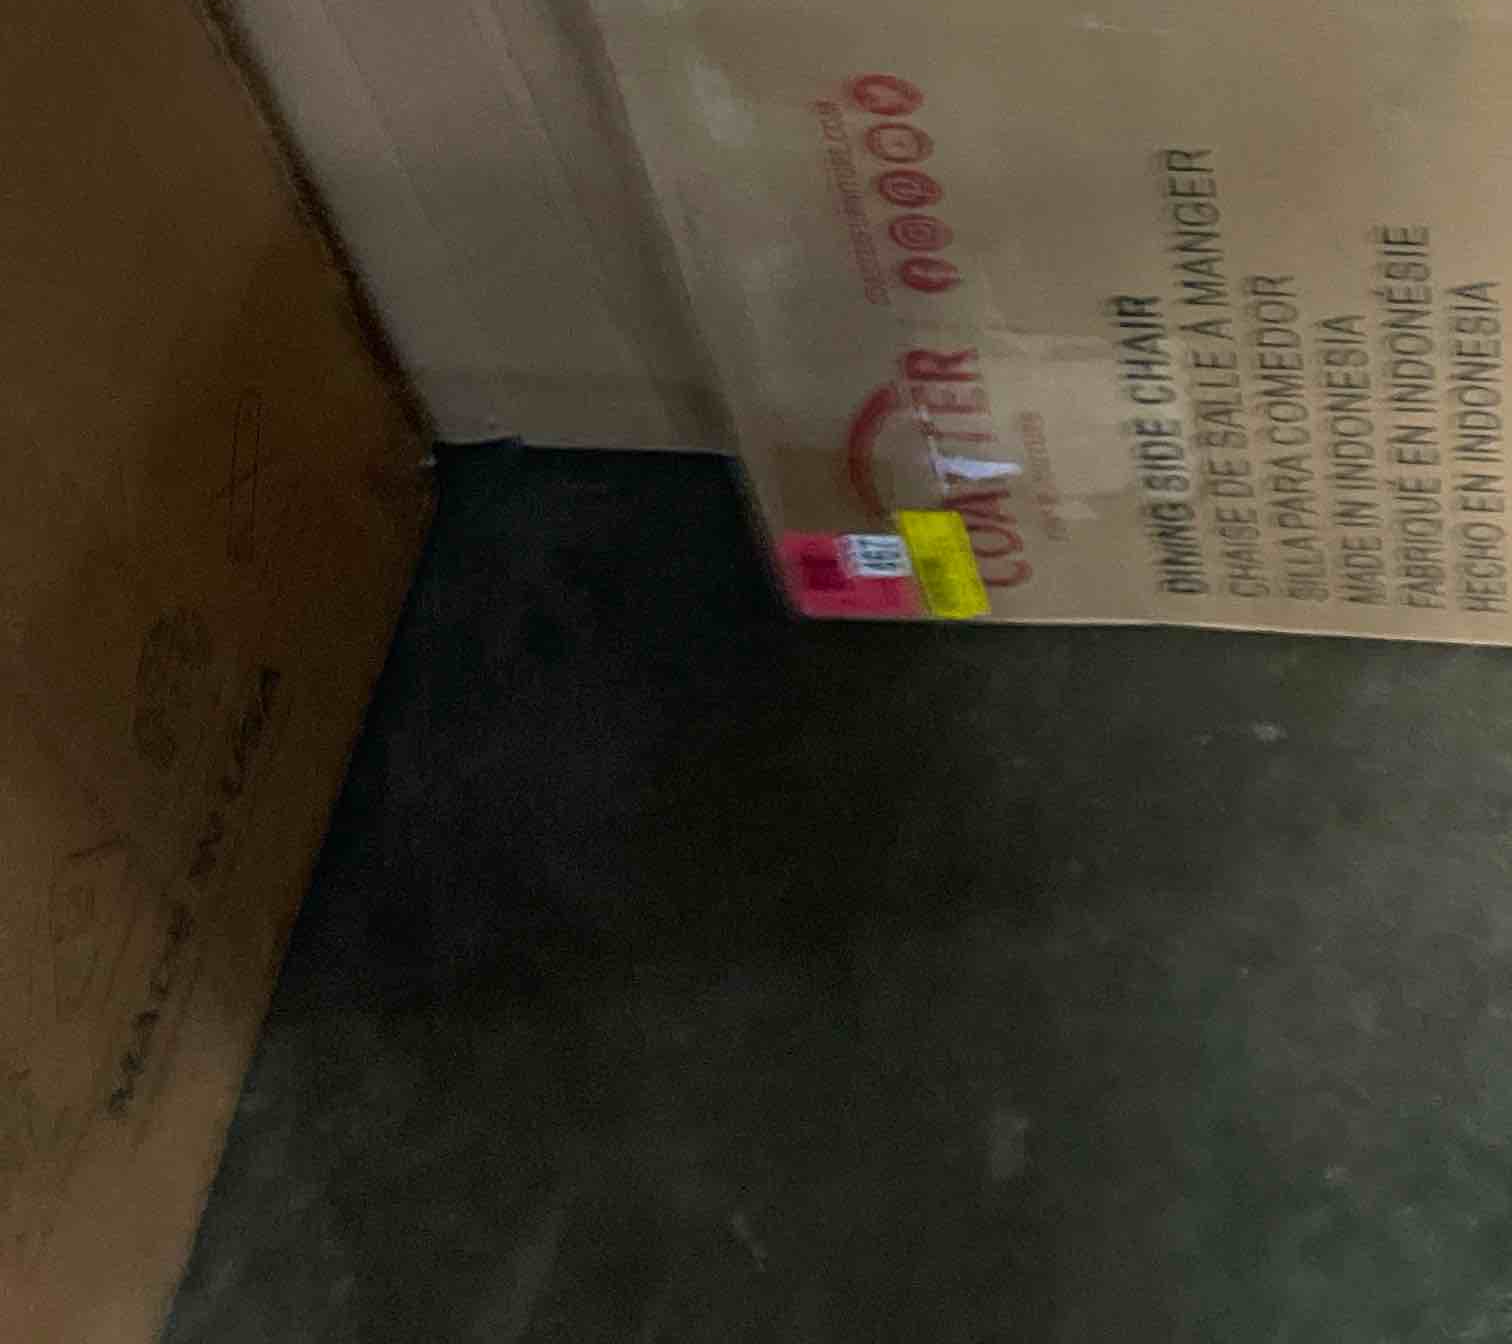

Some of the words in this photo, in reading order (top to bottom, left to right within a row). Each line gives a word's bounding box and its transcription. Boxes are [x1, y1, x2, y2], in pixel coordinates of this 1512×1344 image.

[1160, 147, 1231, 308] MANGER
[1104, 294, 1182, 406] CHAIR
[1242, 274, 1311, 446] COMEDOR
[1370, 225, 1436, 415] INDONÉSIE
[1181, 350, 1250, 450] SALLE
[1308, 314, 1379, 492] INDONESIA
[1436, 280, 1505, 465] INDONESIA
[1125, 418, 1192, 494] SIDE
[1201, 456, 1256, 498] DE
[1384, 423, 1442, 468] EN
[1254, 454, 1319, 532] PARA
[1318, 498, 1380, 529] IN
[1441, 472, 1508, 514] EN
[1145, 502, 1214, 594] DINING
[1208, 506, 1278, 599] CHAISE
[1320, 535, 1390, 606] MADE
[1380, 478, 1449, 612] FABRIQUÉ
[1442, 522, 1511, 615] HECHO
